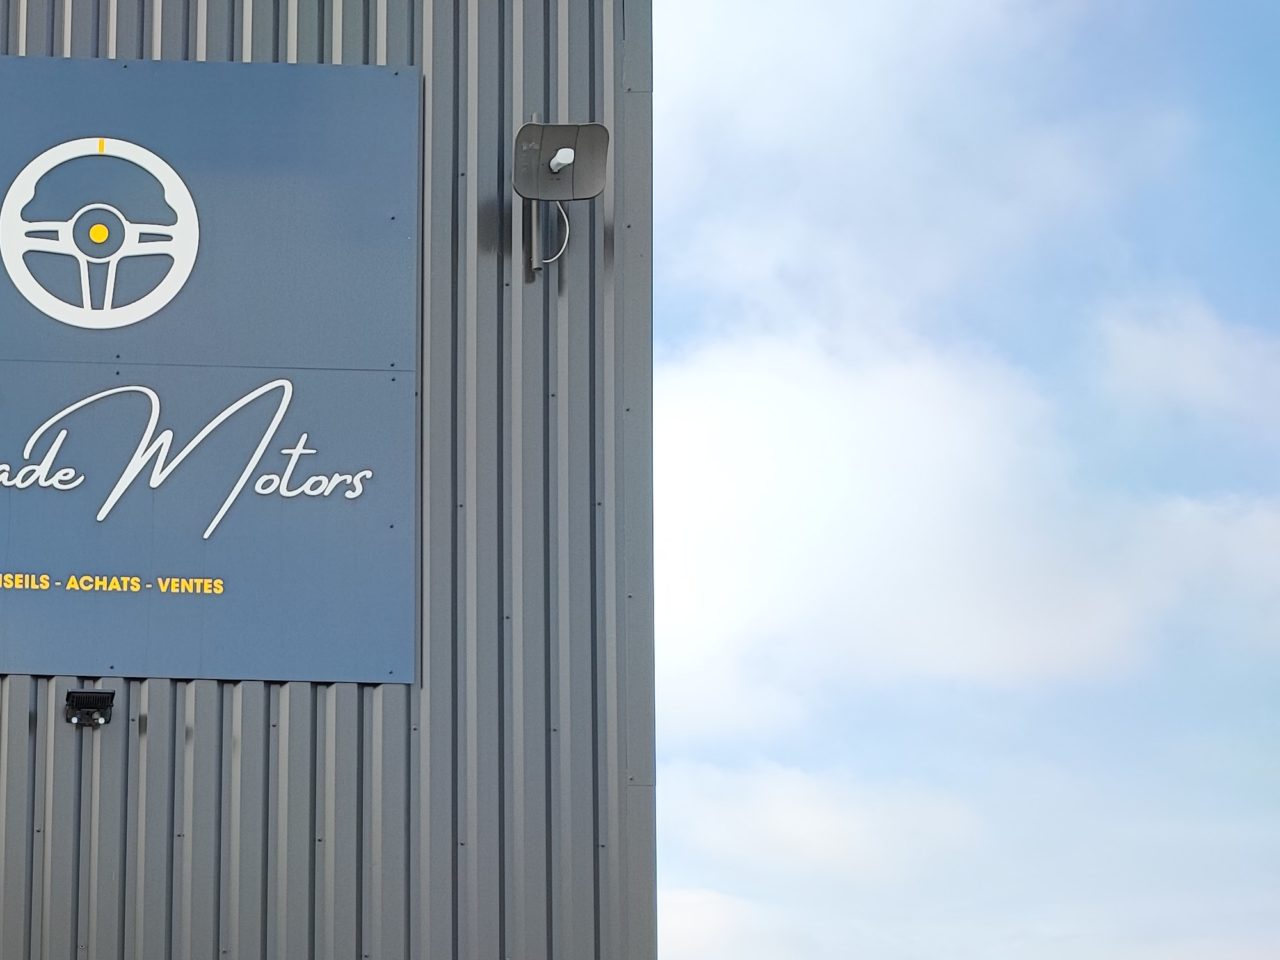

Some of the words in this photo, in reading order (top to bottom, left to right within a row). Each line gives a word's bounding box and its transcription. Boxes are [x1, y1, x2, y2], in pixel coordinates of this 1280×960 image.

[22, 378, 373, 539] Motors
[66, 575, 141, 592] ACHATS
[157, 577, 224, 594] VENTES
